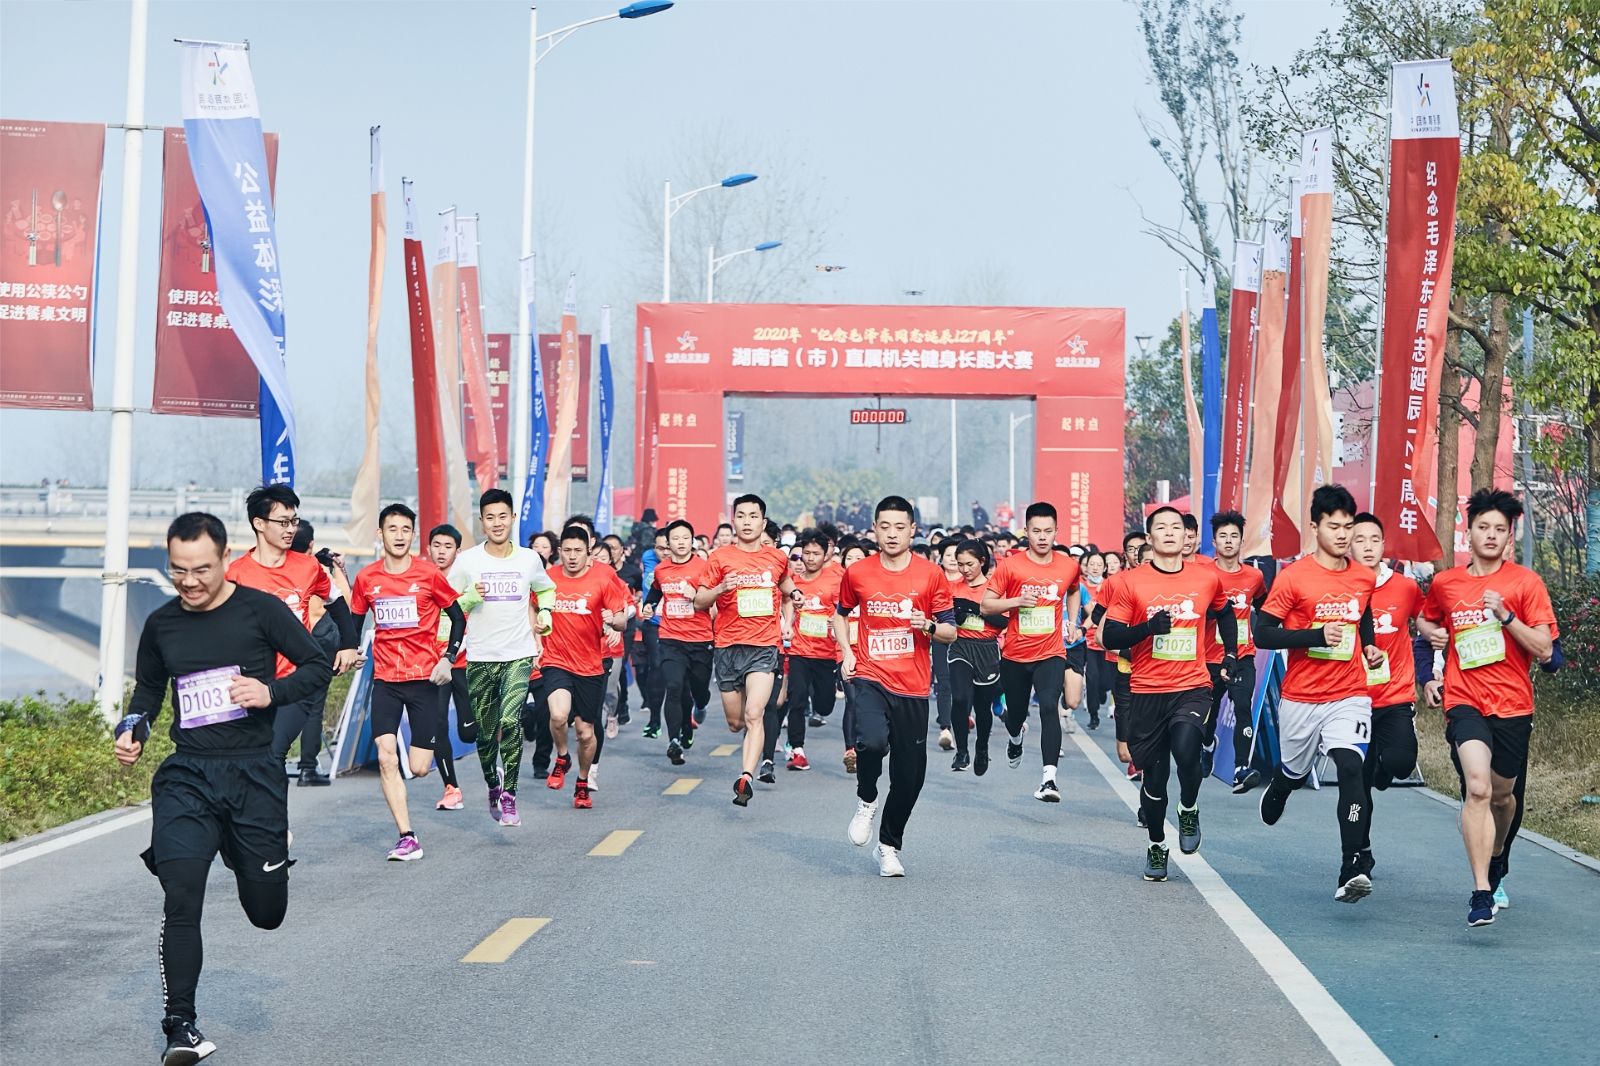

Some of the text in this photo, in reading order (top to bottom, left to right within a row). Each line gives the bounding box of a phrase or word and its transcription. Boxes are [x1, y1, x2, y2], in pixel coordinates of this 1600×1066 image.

[167, 311, 233, 329] 促进餐桌
[753, 327, 802, 343] 2020年
[484, 581, 518, 593] D1026
[377, 607, 411, 621] D1041
[867, 600, 899, 614] 2020
[1020, 615, 1050, 627] C1051
[871, 637, 908, 652] A1189
[1155, 637, 1192, 652] C1073
[1458, 637, 1498, 659] C1039
[182, 687, 228, 714] D103
